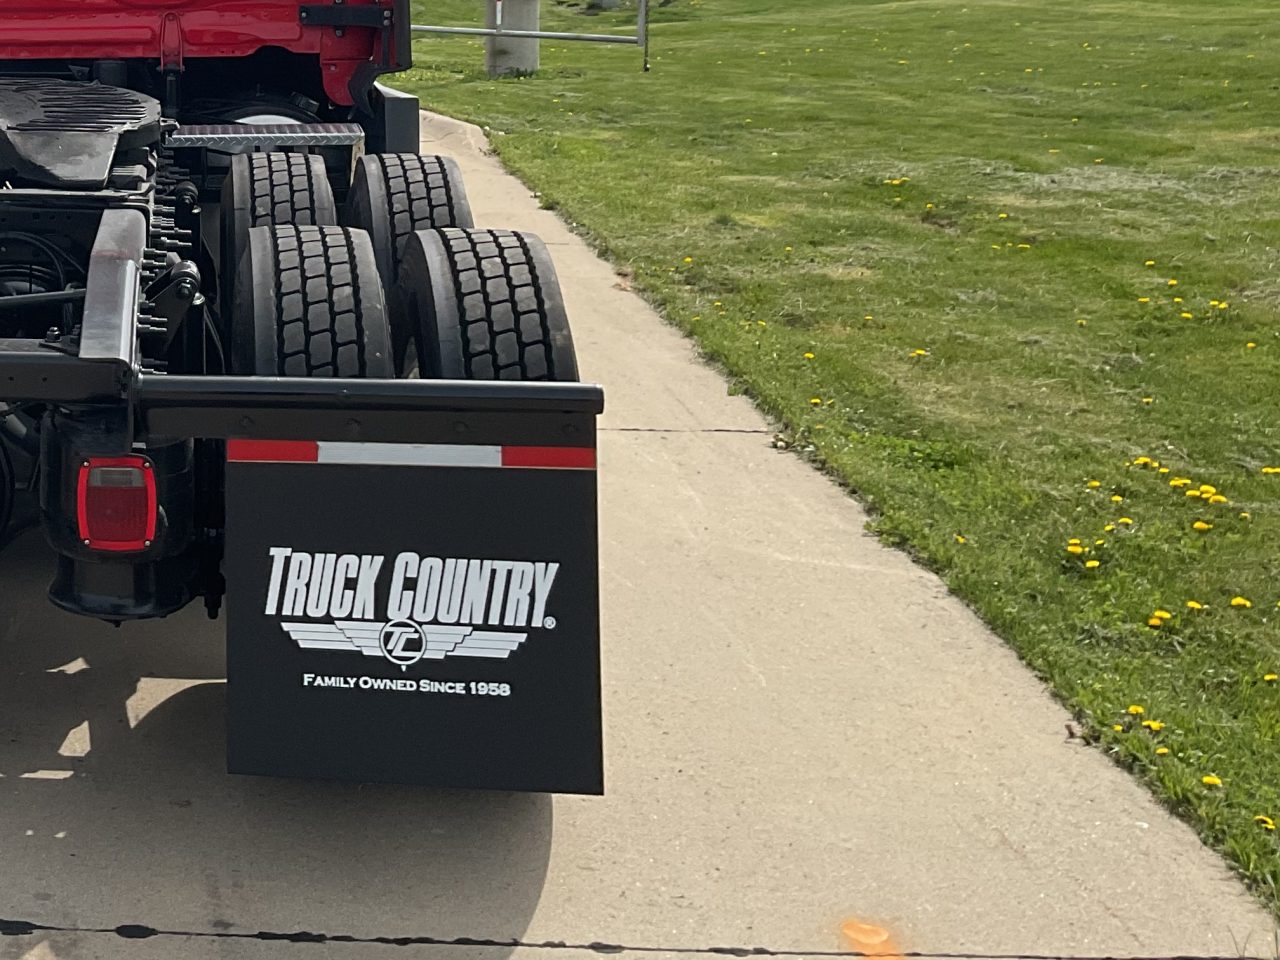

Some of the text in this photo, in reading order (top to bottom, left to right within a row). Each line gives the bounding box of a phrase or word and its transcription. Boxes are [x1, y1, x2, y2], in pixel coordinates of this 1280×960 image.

[265, 546, 560, 628] TRUCK COUNTRY
[303, 673, 511, 697] FAMILY OWNED SINCE 1958
